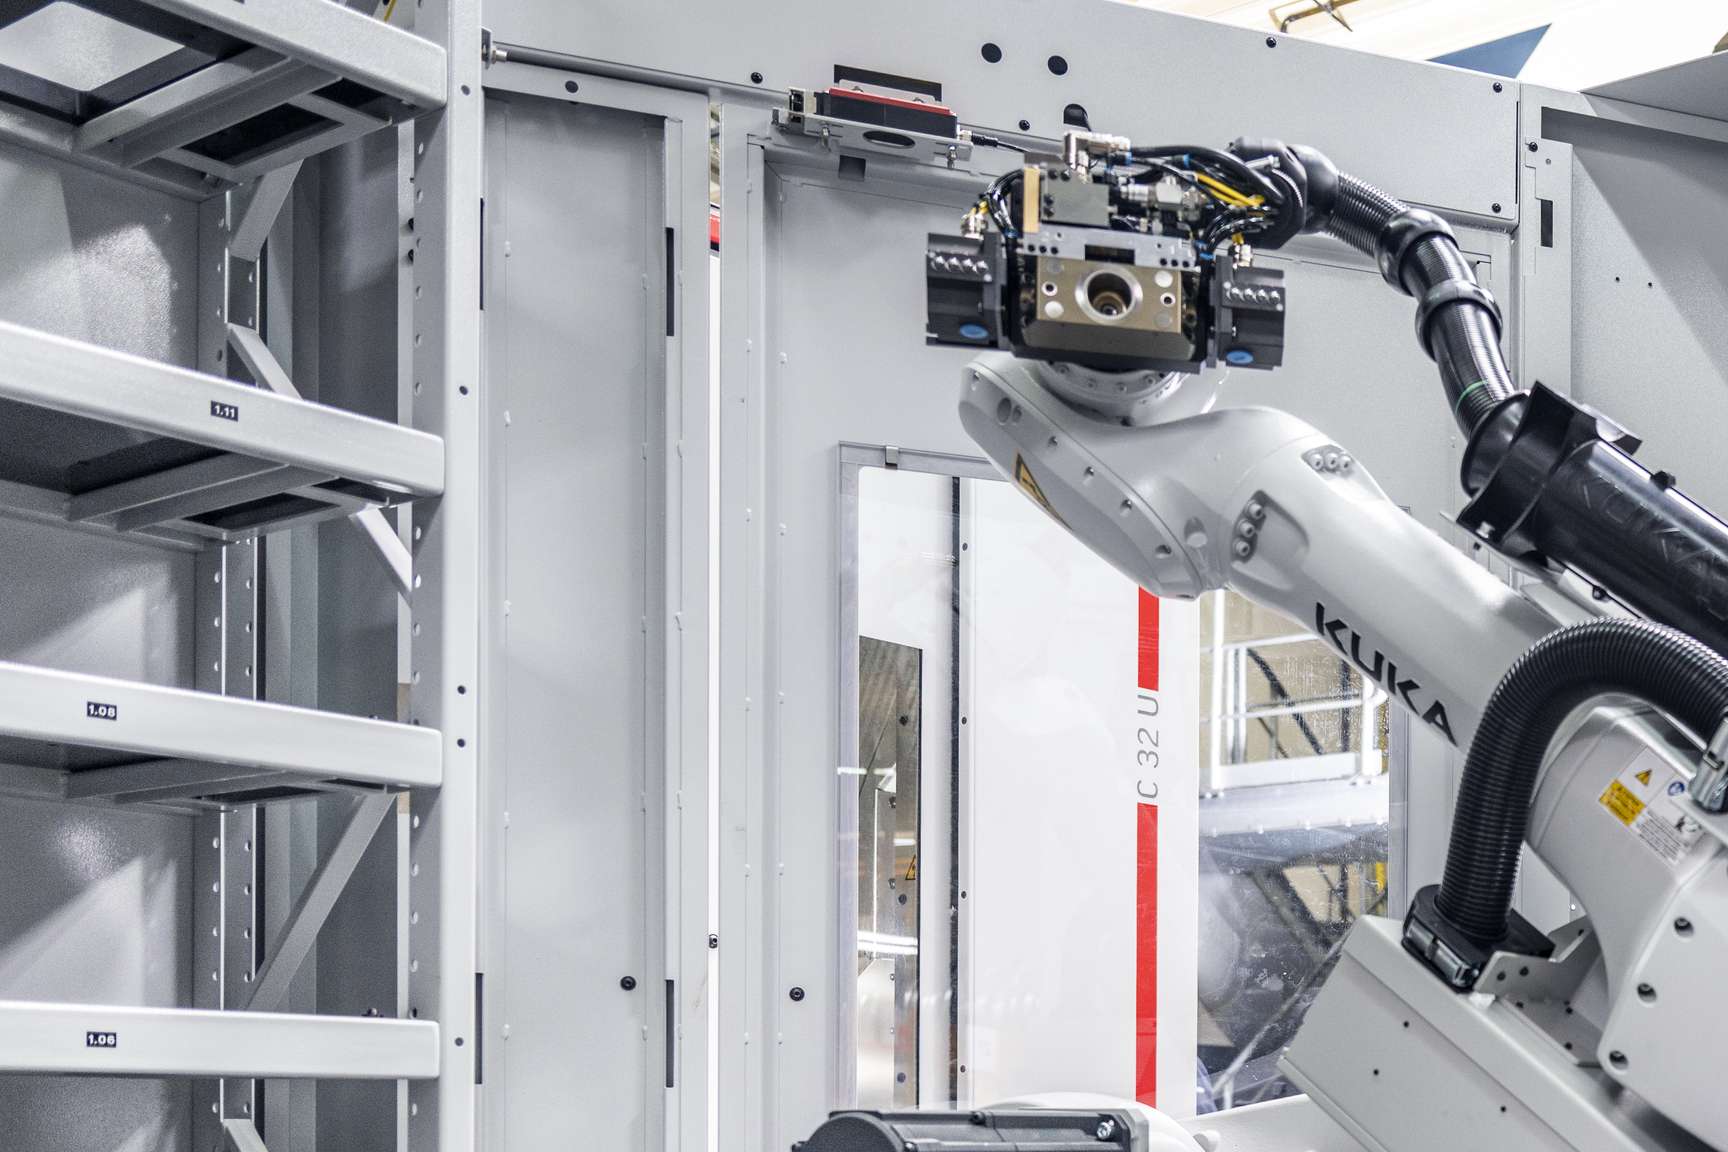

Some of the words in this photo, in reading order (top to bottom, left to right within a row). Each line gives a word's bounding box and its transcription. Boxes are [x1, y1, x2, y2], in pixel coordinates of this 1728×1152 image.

[214, 404, 236, 419] 1.11
[1315, 601, 1458, 747] KUKA
[88, 704, 116, 718] 1.08
[1136, 694, 1159, 717] U
[1136, 727, 1159, 769] 32
[1136, 779, 1159, 799] C
[88, 1033, 116, 1046] 1.06
